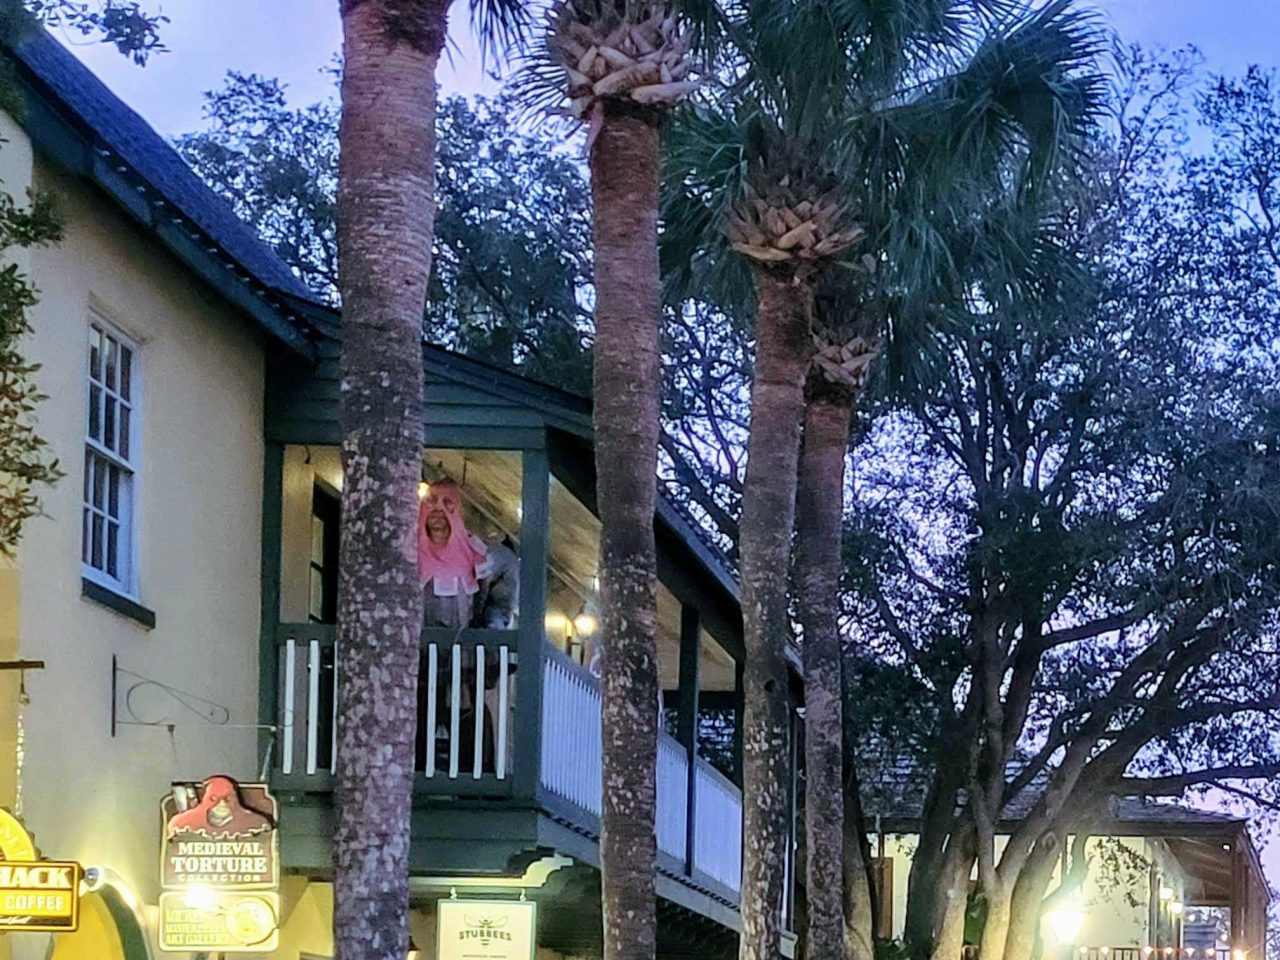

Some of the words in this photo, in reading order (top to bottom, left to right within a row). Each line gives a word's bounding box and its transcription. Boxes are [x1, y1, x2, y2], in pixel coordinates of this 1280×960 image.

[178, 842, 263, 855] MEDIEVAL
[171, 857, 267, 873] TORTURE
[178, 874, 260, 882] COLLECTION
[5, 895, 64, 911] COFFEE
[459, 929, 512, 941] STUBBEES
